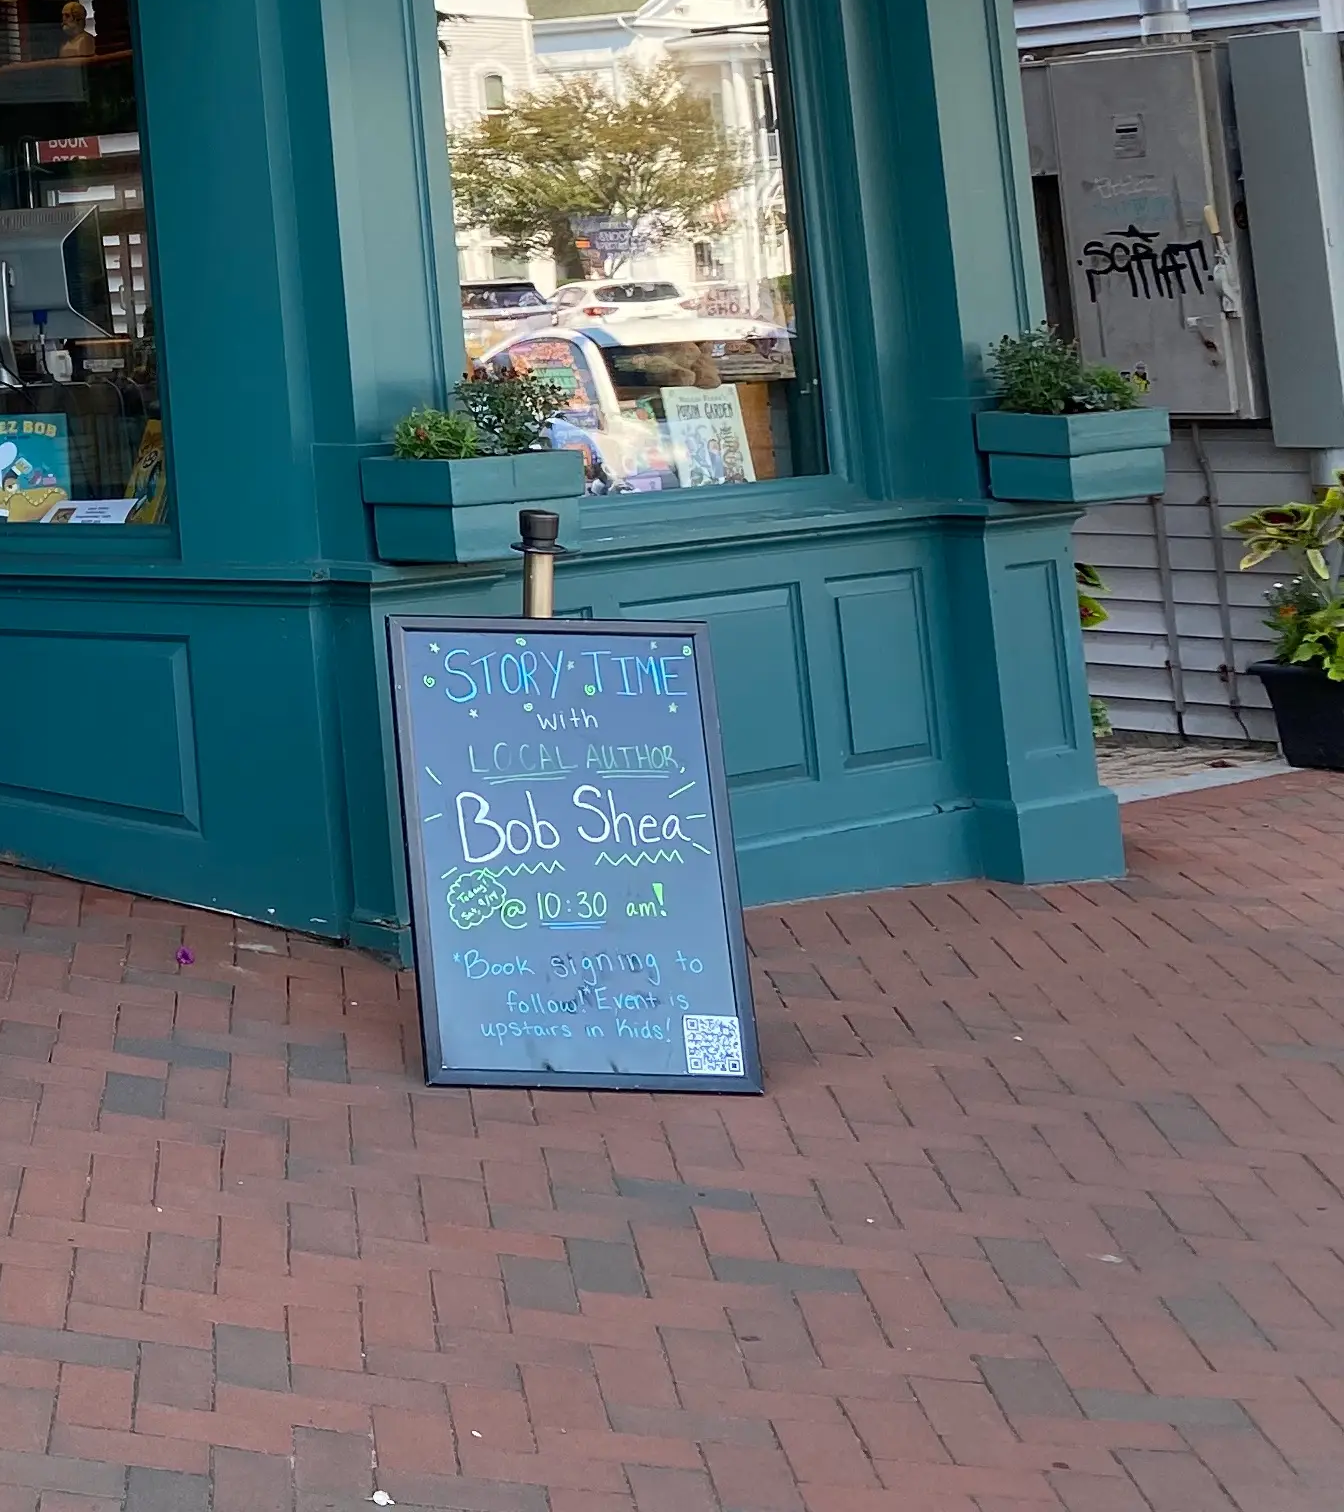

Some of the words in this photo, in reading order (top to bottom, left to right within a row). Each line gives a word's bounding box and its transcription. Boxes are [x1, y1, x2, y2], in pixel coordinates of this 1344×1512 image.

[704, 402, 733, 419] GARDEN
[23, 420, 57, 438] BOB
[445, 649, 563, 703] STORY
[581, 651, 688, 696] TIME
[537, 707, 598, 731] with
[469, 742, 578, 773] LOCAL
[586, 744, 685, 774] AUTHOR,
[456, 790, 561, 863] Bob
[573, 785, 691, 846] Shea
[501, 899, 528, 929] @
[537, 891, 607, 920] 10:30
[626, 882, 667, 918] am!
[551, 951, 661, 986] signing
[676, 950, 703, 974] to
[596, 987, 659, 1014] Event
[669, 991, 689, 1010] is
[481, 1019, 571, 1046] upstairs
[585, 1025, 604, 1038] in
